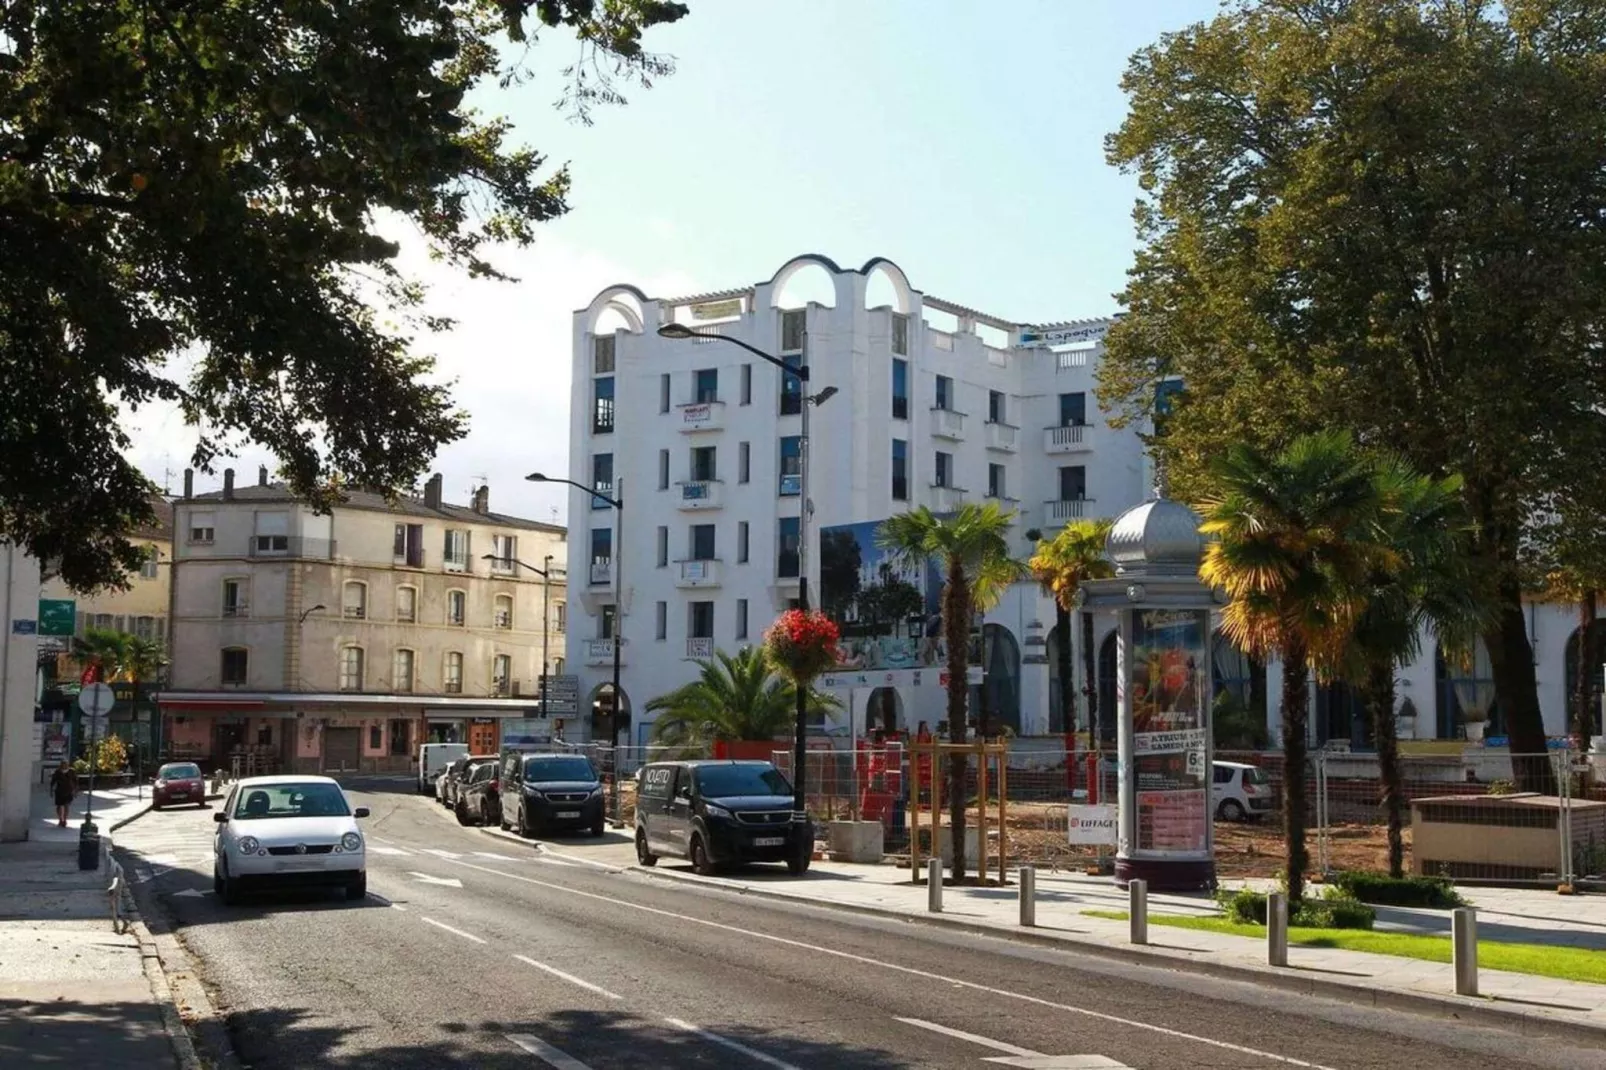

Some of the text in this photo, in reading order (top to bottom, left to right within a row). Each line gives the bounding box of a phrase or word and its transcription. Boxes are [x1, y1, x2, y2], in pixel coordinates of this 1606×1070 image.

[1151, 732, 1187, 742] ATRIUM
[1151, 741, 1184, 750] SAMEDI
[1081, 819, 1114, 828] EIFFAGE
